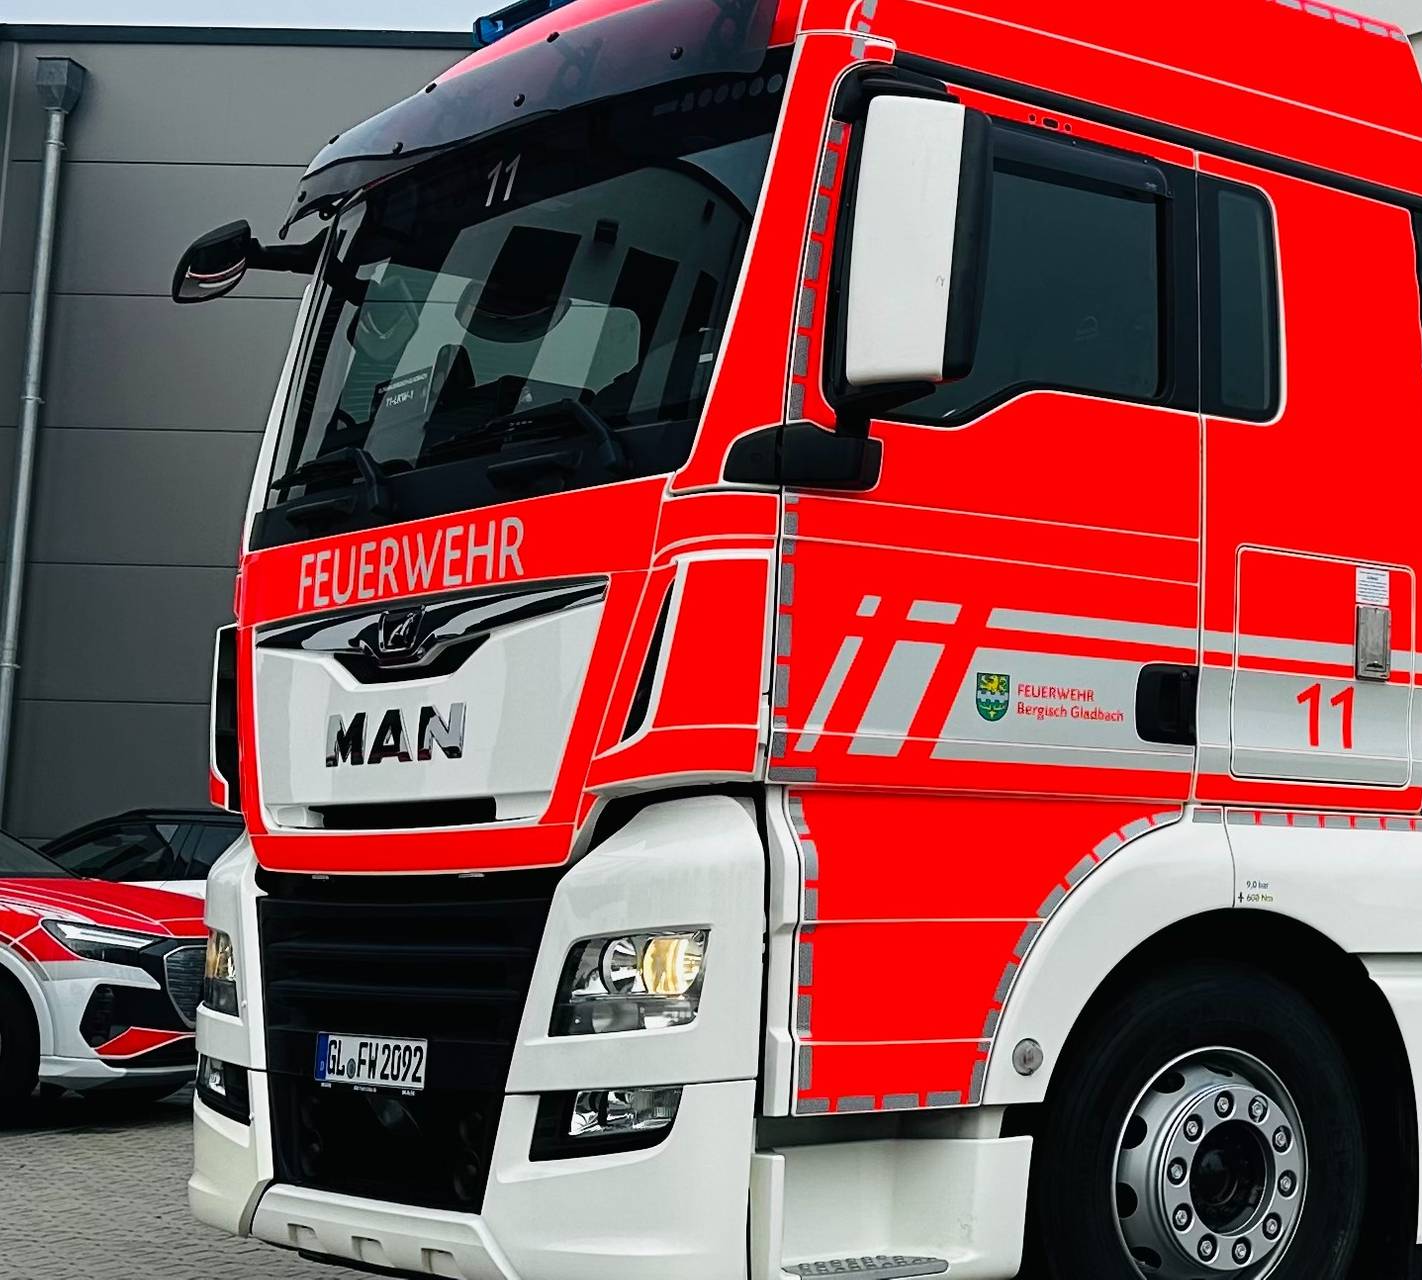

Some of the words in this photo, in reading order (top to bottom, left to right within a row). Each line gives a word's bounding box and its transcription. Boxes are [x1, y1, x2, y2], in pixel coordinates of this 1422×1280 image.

[485, 154, 520, 206] 11
[298, 516, 524, 610] FEUERWEHR
[1017, 683, 1095, 702] FEUERWEHR
[1017, 701, 1068, 721] Bergisch
[1070, 705, 1125, 723] Gladbach
[1296, 683, 1355, 750] 11
[326, 702, 467, 768] MAN
